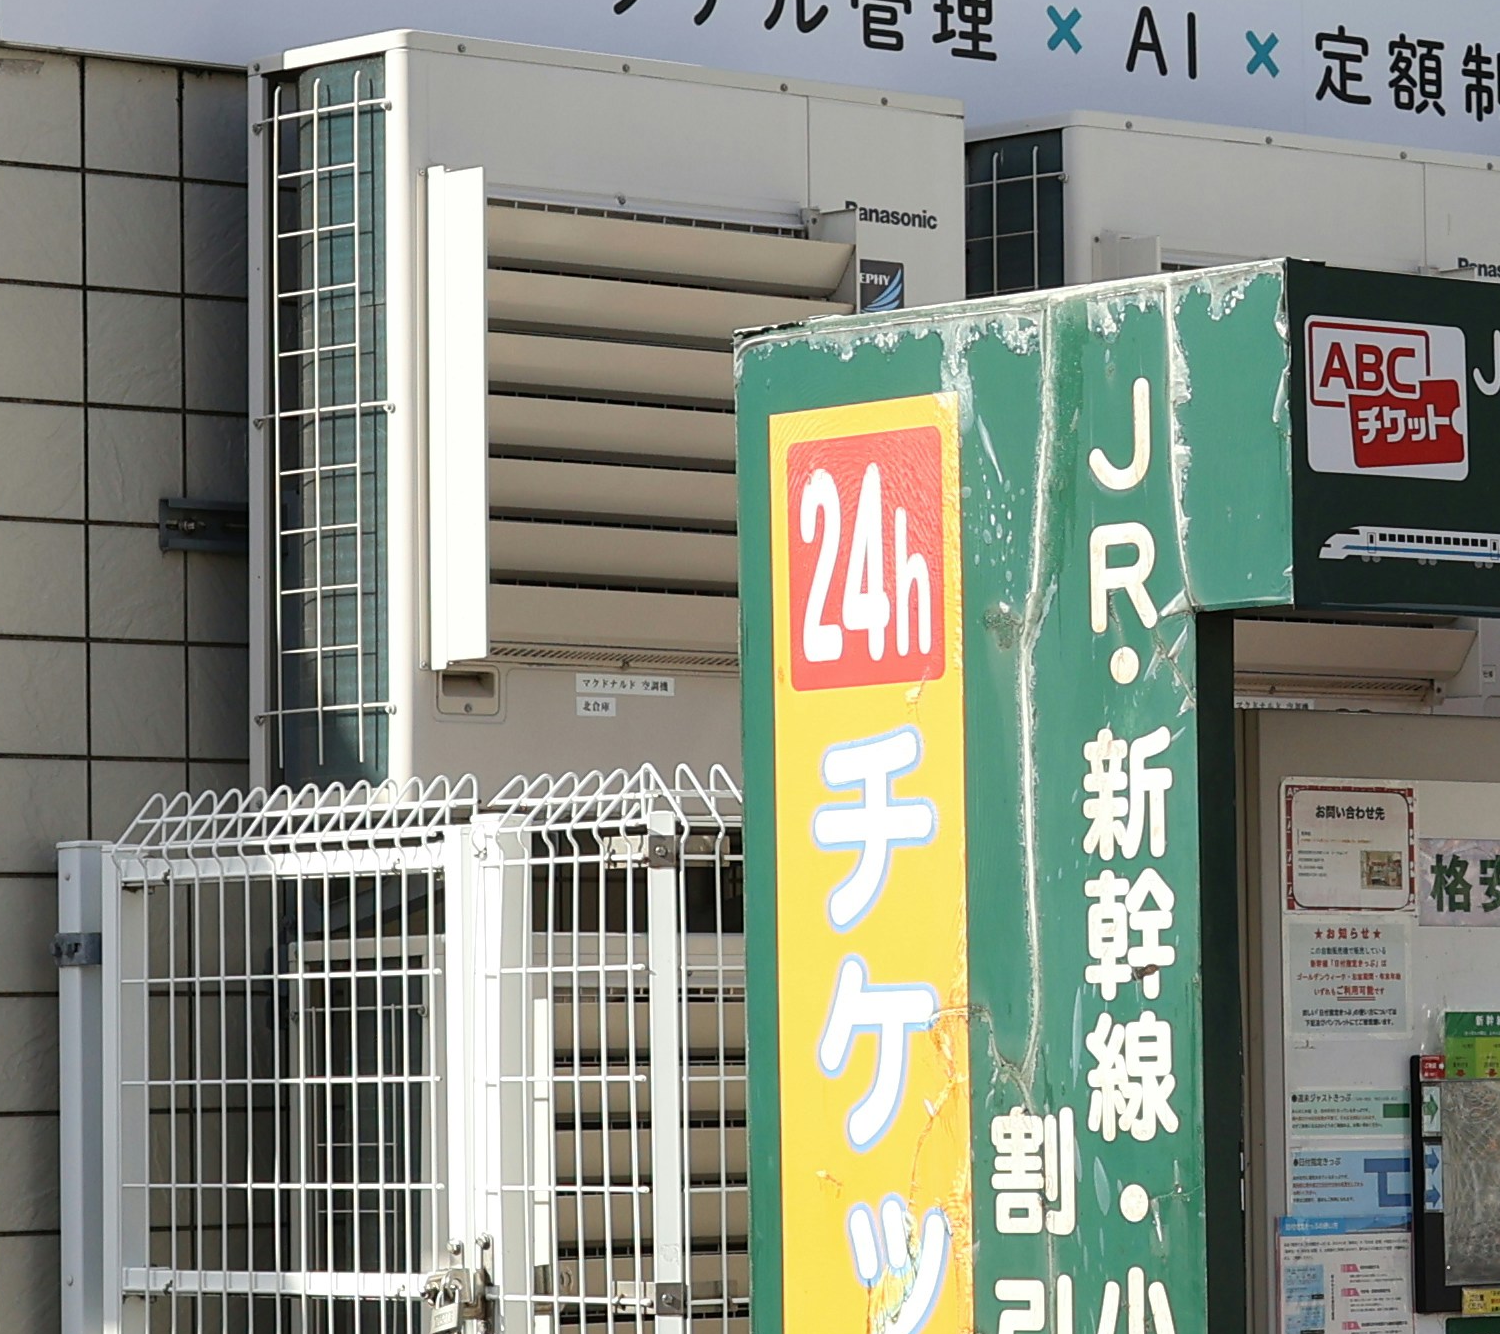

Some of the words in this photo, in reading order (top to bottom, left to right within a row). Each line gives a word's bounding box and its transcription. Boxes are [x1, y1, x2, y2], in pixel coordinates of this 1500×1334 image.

[1125, 5, 1198, 80] AI
[1319, 341, 1417, 394] ABC
[1357, 405, 1451, 444] チケット
[800, 461, 933, 665] 24h
[582, 678, 636, 690] マクドナルド
[1315, 805, 1385, 821] お問い合わせ先
